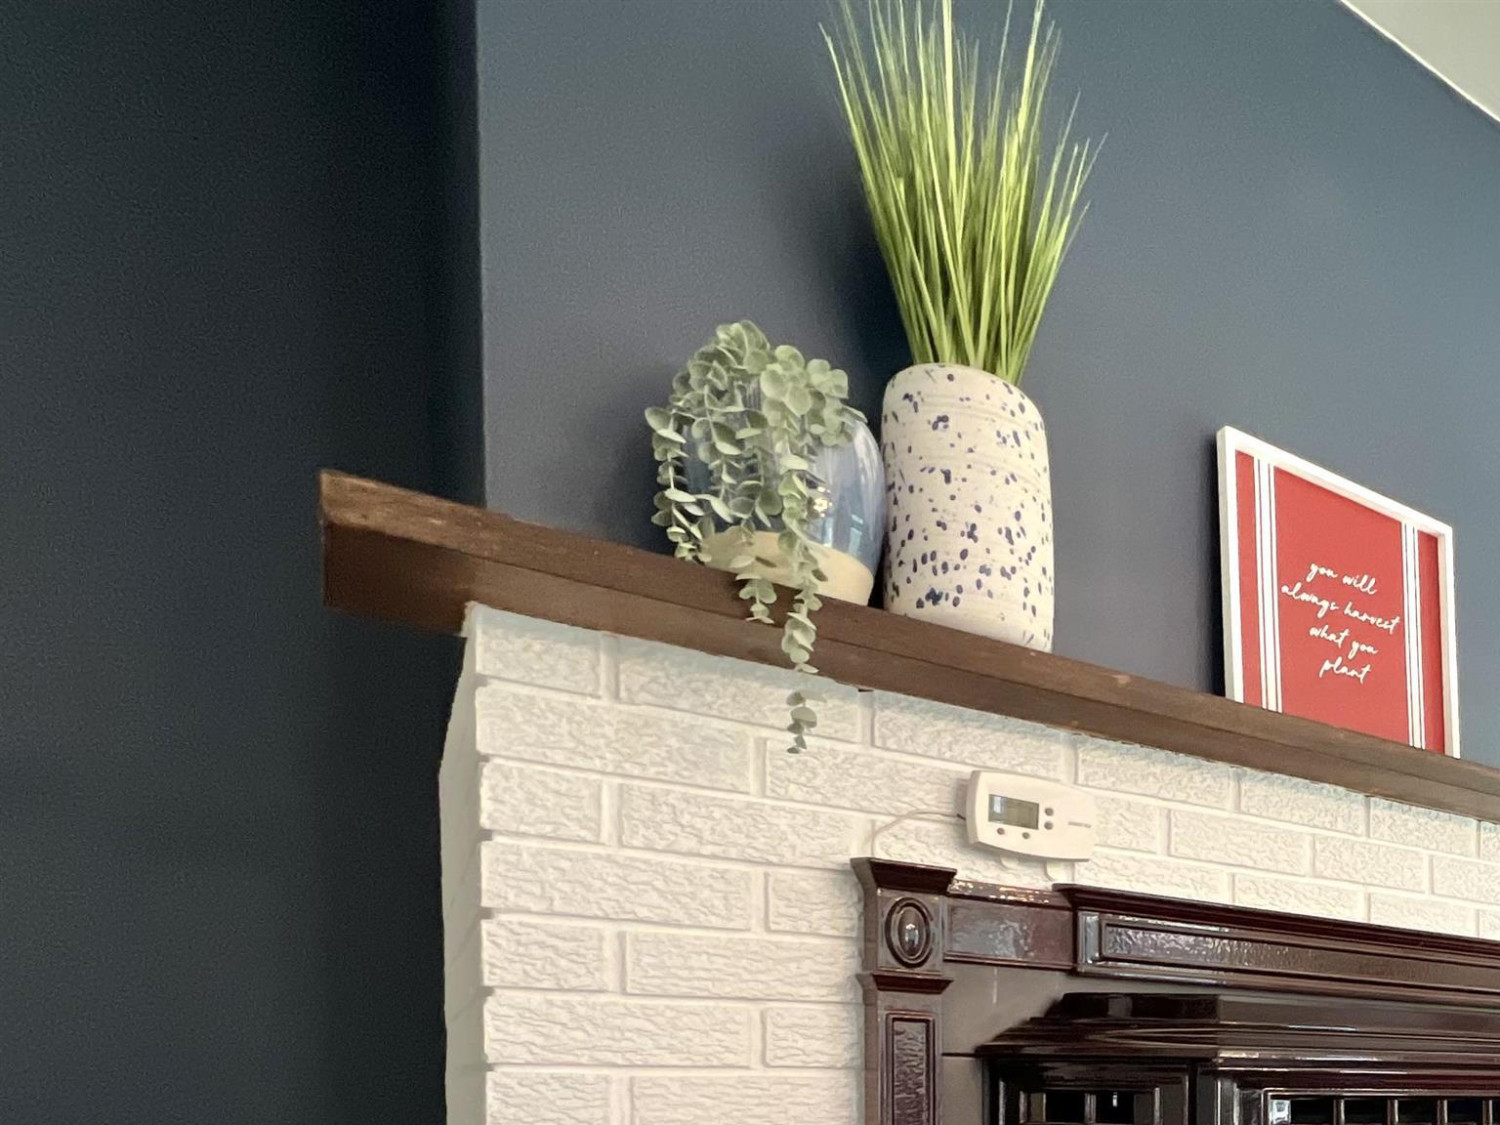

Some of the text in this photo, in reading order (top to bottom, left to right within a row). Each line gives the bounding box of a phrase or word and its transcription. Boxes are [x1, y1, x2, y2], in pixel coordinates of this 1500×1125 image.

[1305, 563, 1377, 595] you will
[1280, 581, 1401, 635] always harvest
[1309, 624, 1379, 661] what you
[1318, 656, 1372, 684] plant
